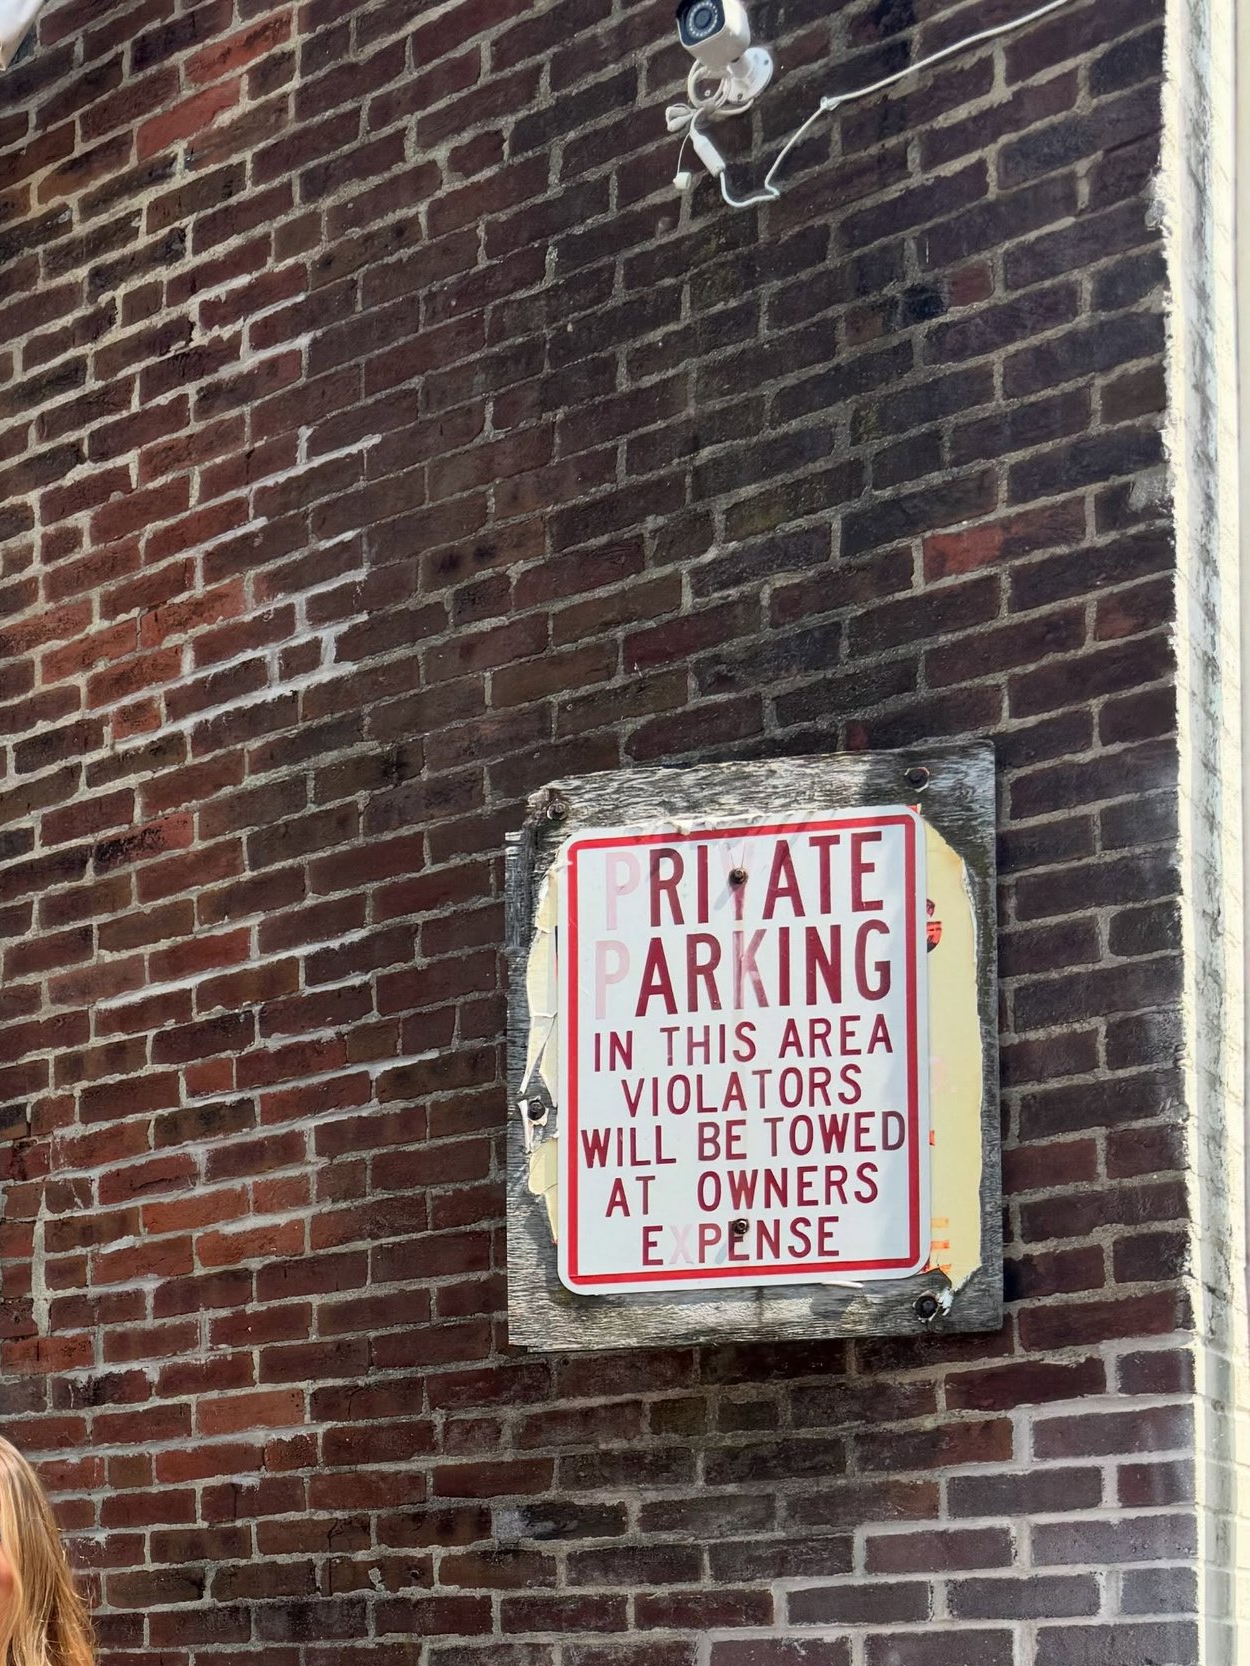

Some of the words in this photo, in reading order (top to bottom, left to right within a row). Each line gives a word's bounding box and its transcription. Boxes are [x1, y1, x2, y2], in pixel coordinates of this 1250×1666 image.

[605, 831, 883, 930] PRIVATE
[595, 919, 891, 1019] PARKING
[594, 1030, 633, 1072] IN
[660, 1021, 757, 1067] THIS
[778, 1013, 893, 1058] AREA
[621, 1064, 862, 1118] VIOLATORS
[580, 1126, 677, 1169] WILL
[697, 1119, 747, 1161] BE
[763, 1110, 905, 1157] TOWED
[605, 1175, 656, 1217] AT
[697, 1162, 879, 1212] OWNERS
[642, 1216, 840, 1266] EXPENSE
